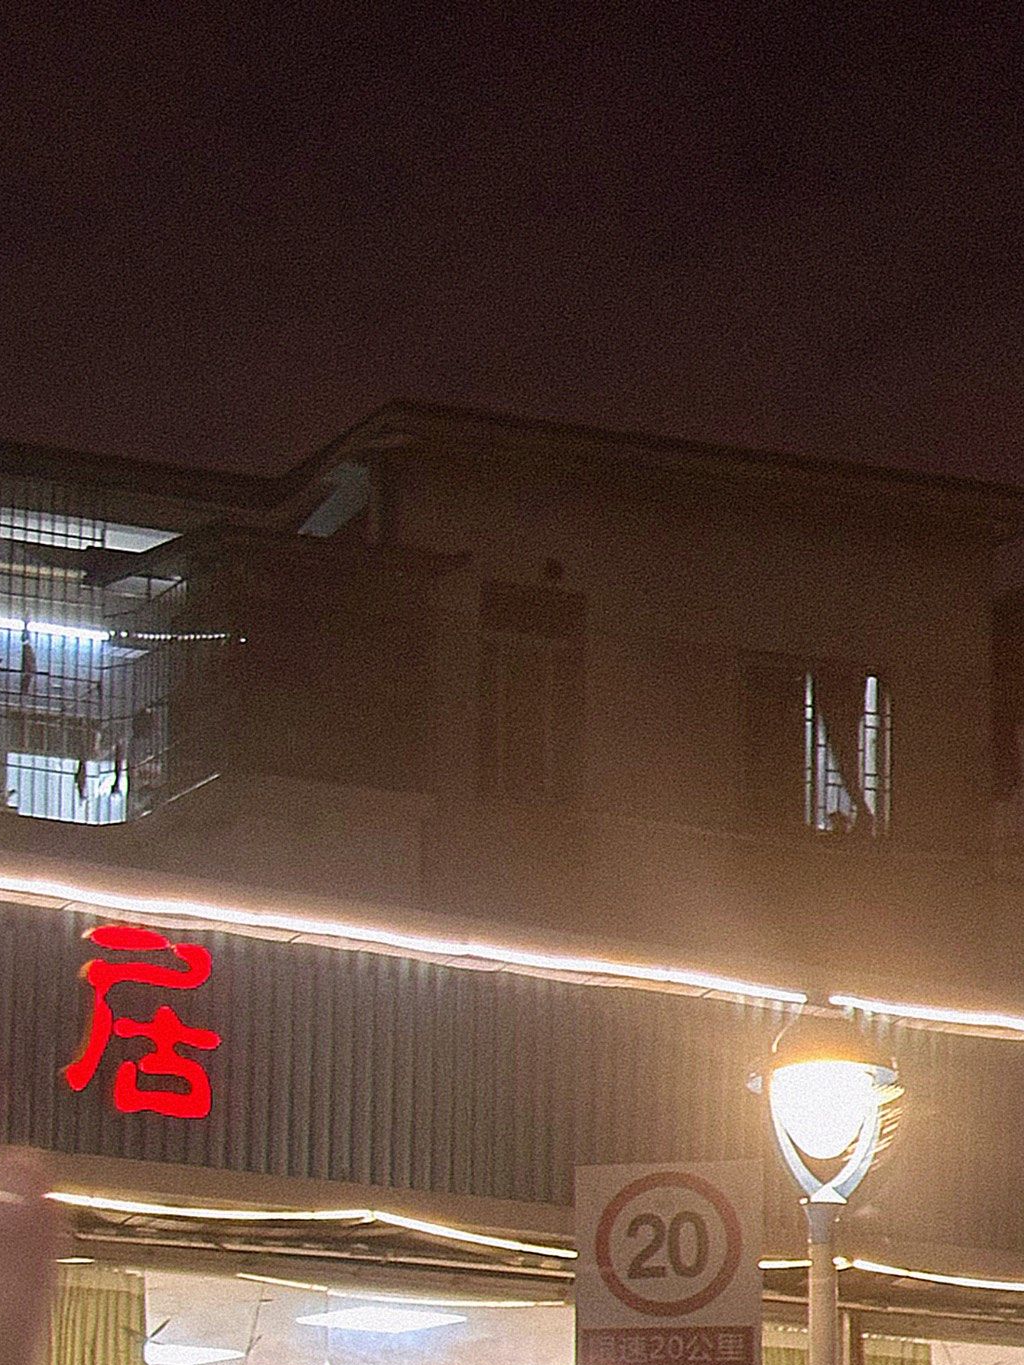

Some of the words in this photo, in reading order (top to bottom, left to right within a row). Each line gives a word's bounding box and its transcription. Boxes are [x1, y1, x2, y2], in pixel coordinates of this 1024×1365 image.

[627, 1210, 709, 1280] 20
[588, 1333, 744, 1363] 限速20公里
